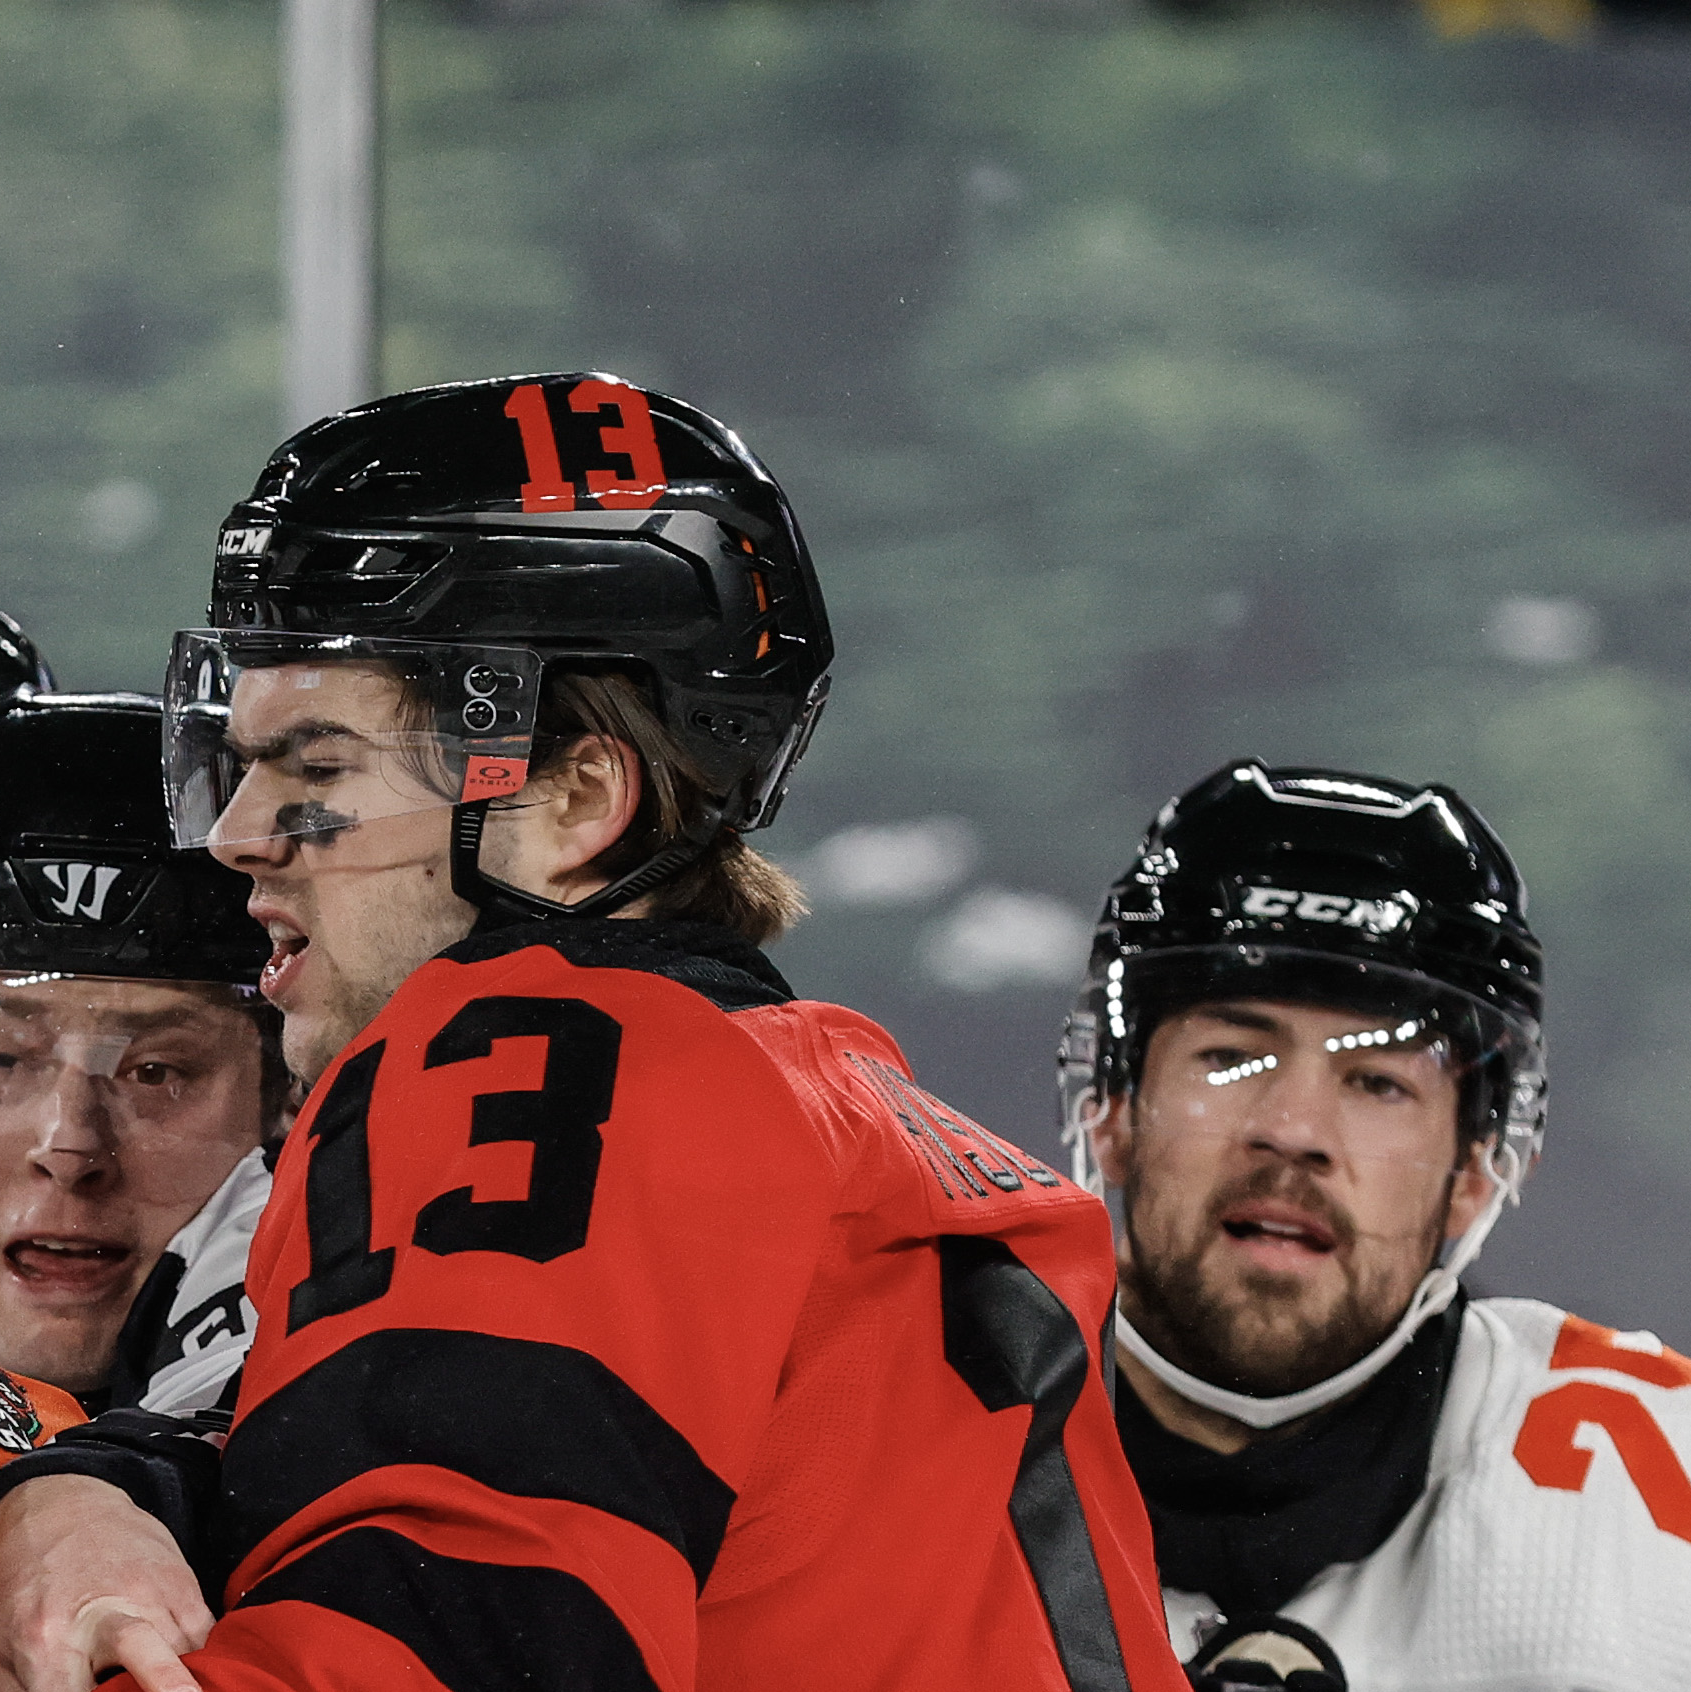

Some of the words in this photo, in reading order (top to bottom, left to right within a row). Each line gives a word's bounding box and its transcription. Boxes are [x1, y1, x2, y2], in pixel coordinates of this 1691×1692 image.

[503, 379, 667, 513] 13
[1241, 886, 1407, 934] CCM
[286, 996, 622, 1338] 13
